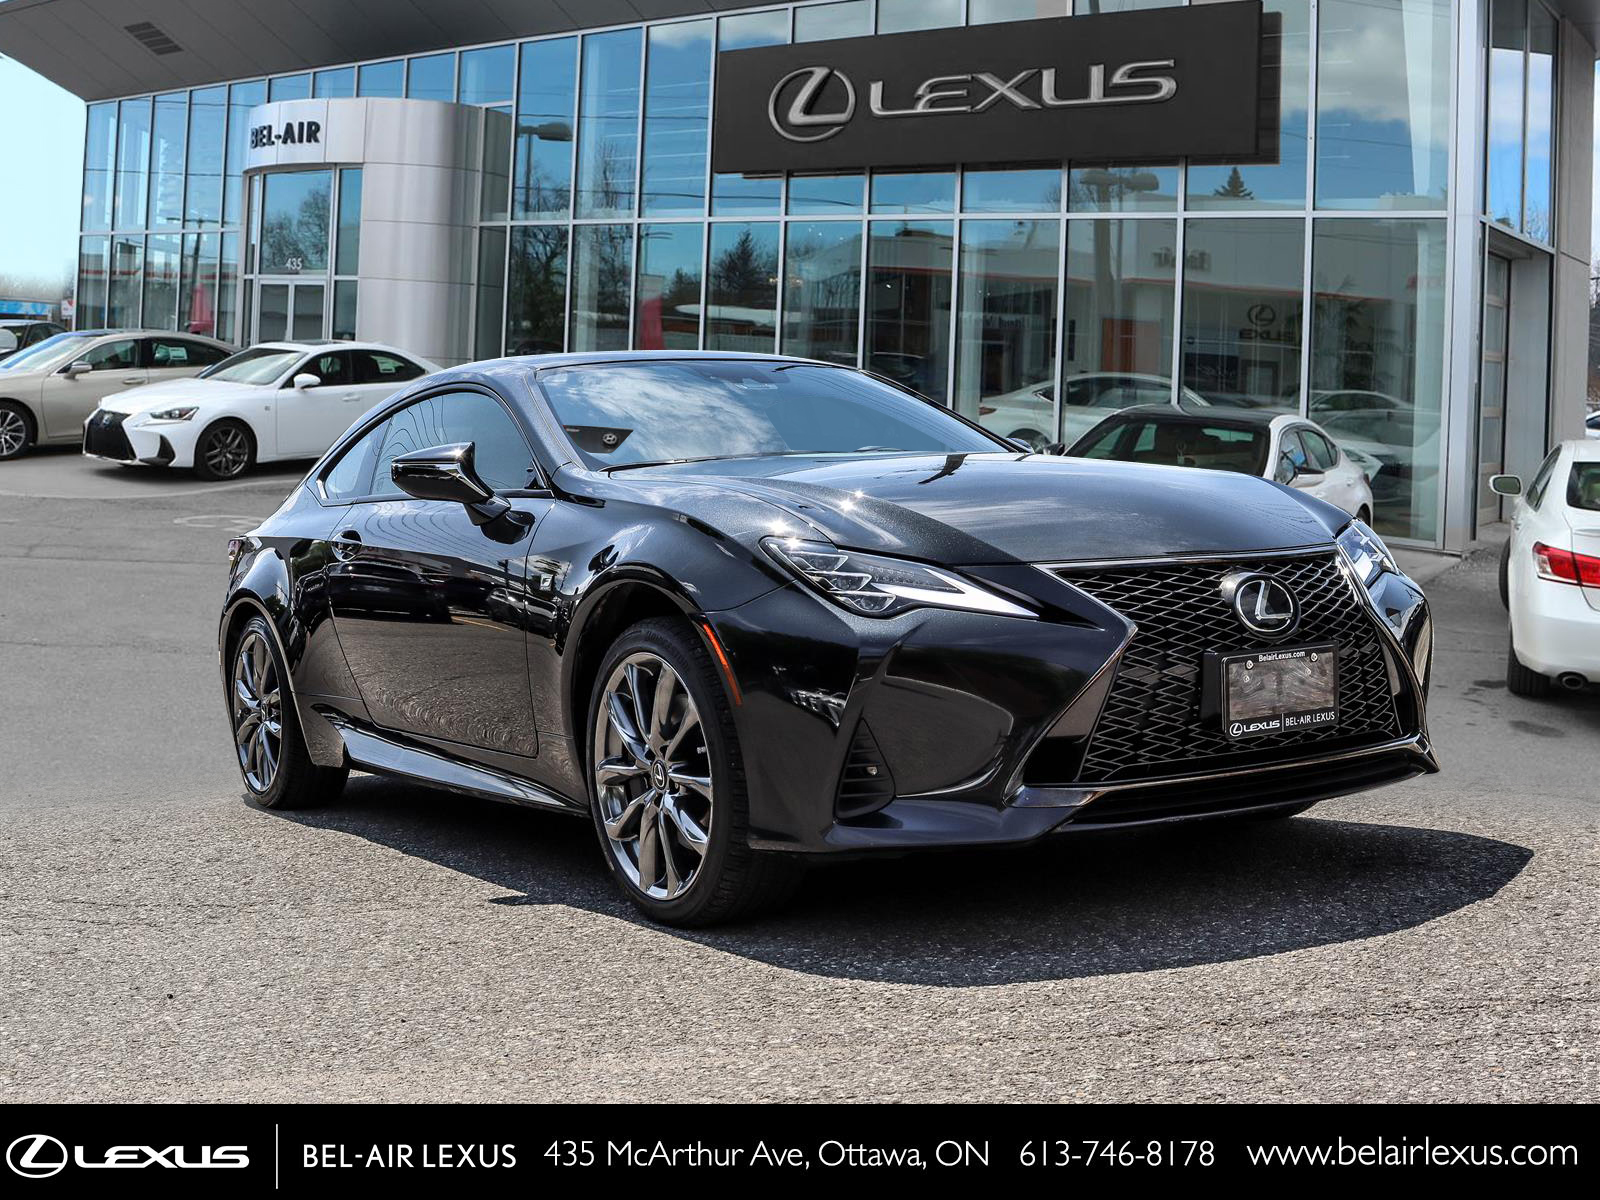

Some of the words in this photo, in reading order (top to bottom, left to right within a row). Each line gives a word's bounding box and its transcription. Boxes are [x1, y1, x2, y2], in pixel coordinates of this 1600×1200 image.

[869, 59, 1178, 117] LEXUS
[250, 121, 321, 149] BEL-AIR
[285, 257, 303, 270] 435
[1258, 650, 1306, 662] BelairLexus.com
[1285, 714, 1312, 727] BEL-AIR
[1312, 711, 1335, 724] LEXUS
[1243, 720, 1281, 733] LEXUS
